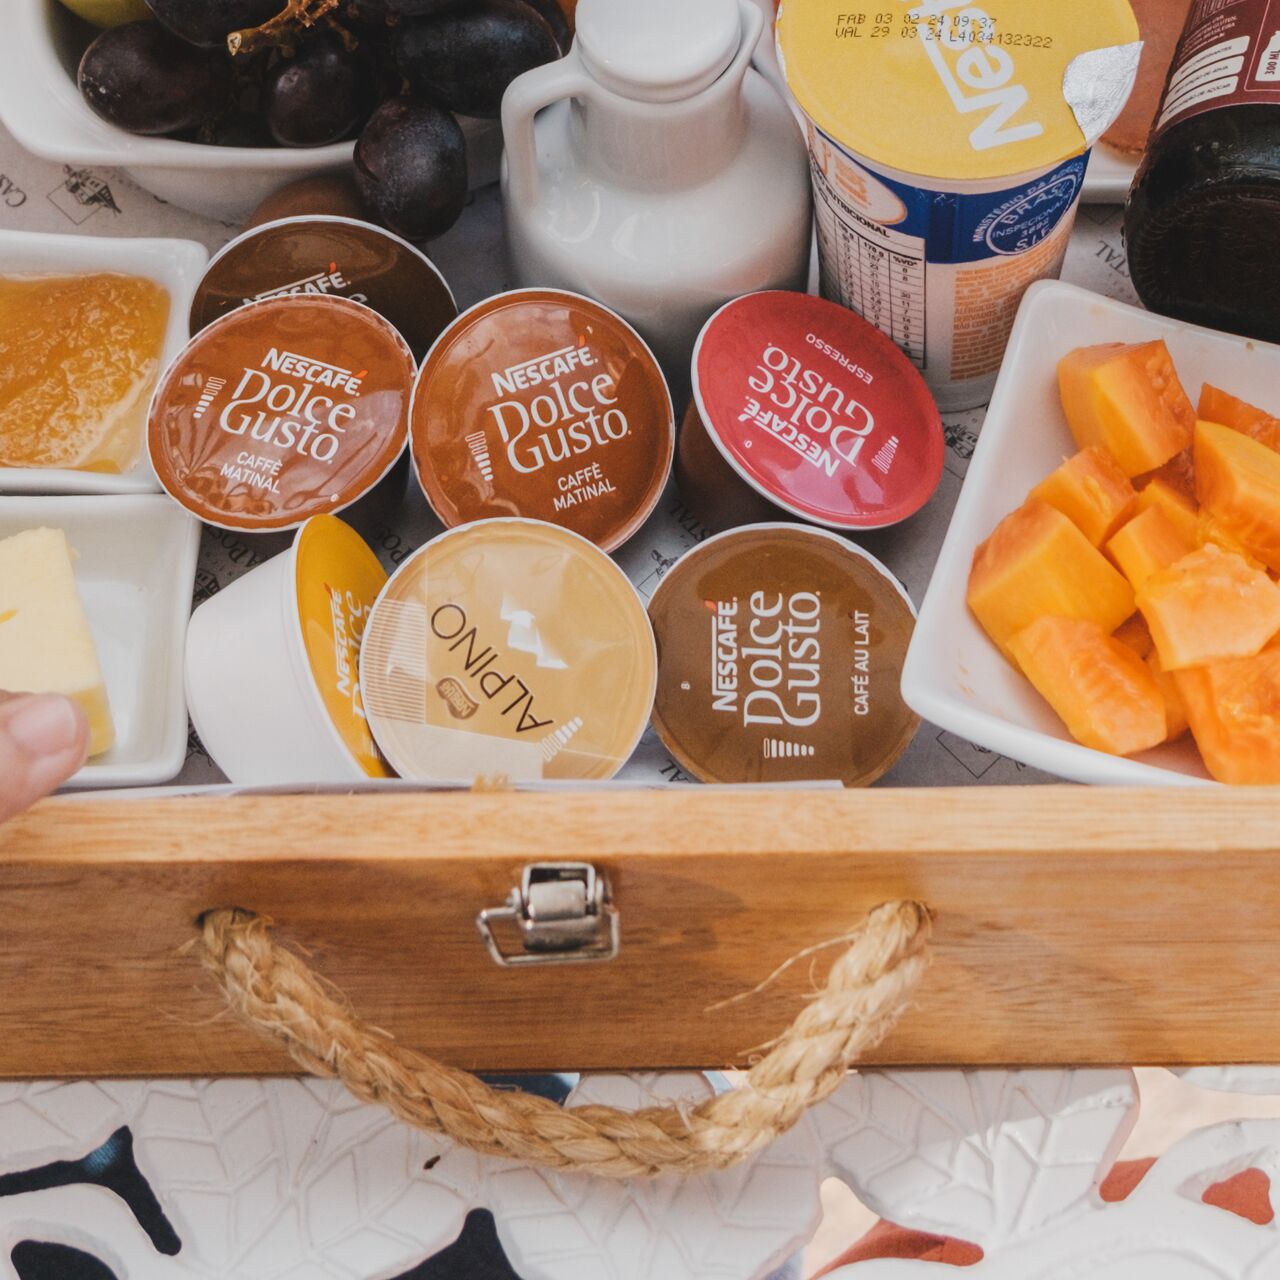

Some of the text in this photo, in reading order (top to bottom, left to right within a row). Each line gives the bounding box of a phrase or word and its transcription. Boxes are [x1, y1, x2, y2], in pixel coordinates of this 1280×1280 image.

[835, 26, 863, 39] VAL
[836, 13, 867, 27] FAB
[875, 12, 893, 26] 03
[805, 332, 874, 384] ESPRESSO
[232, 367, 357, 434] Dolce
[488, 373, 619, 444] Dolce
[220, 463, 282, 496] MATINAL
[553, 479, 617, 513] MATINAL
[431, 603, 554, 734] ALPINO
[743, 590, 783, 728] Dolce
[853, 610, 870, 716] CAFÉ AU LAIT
